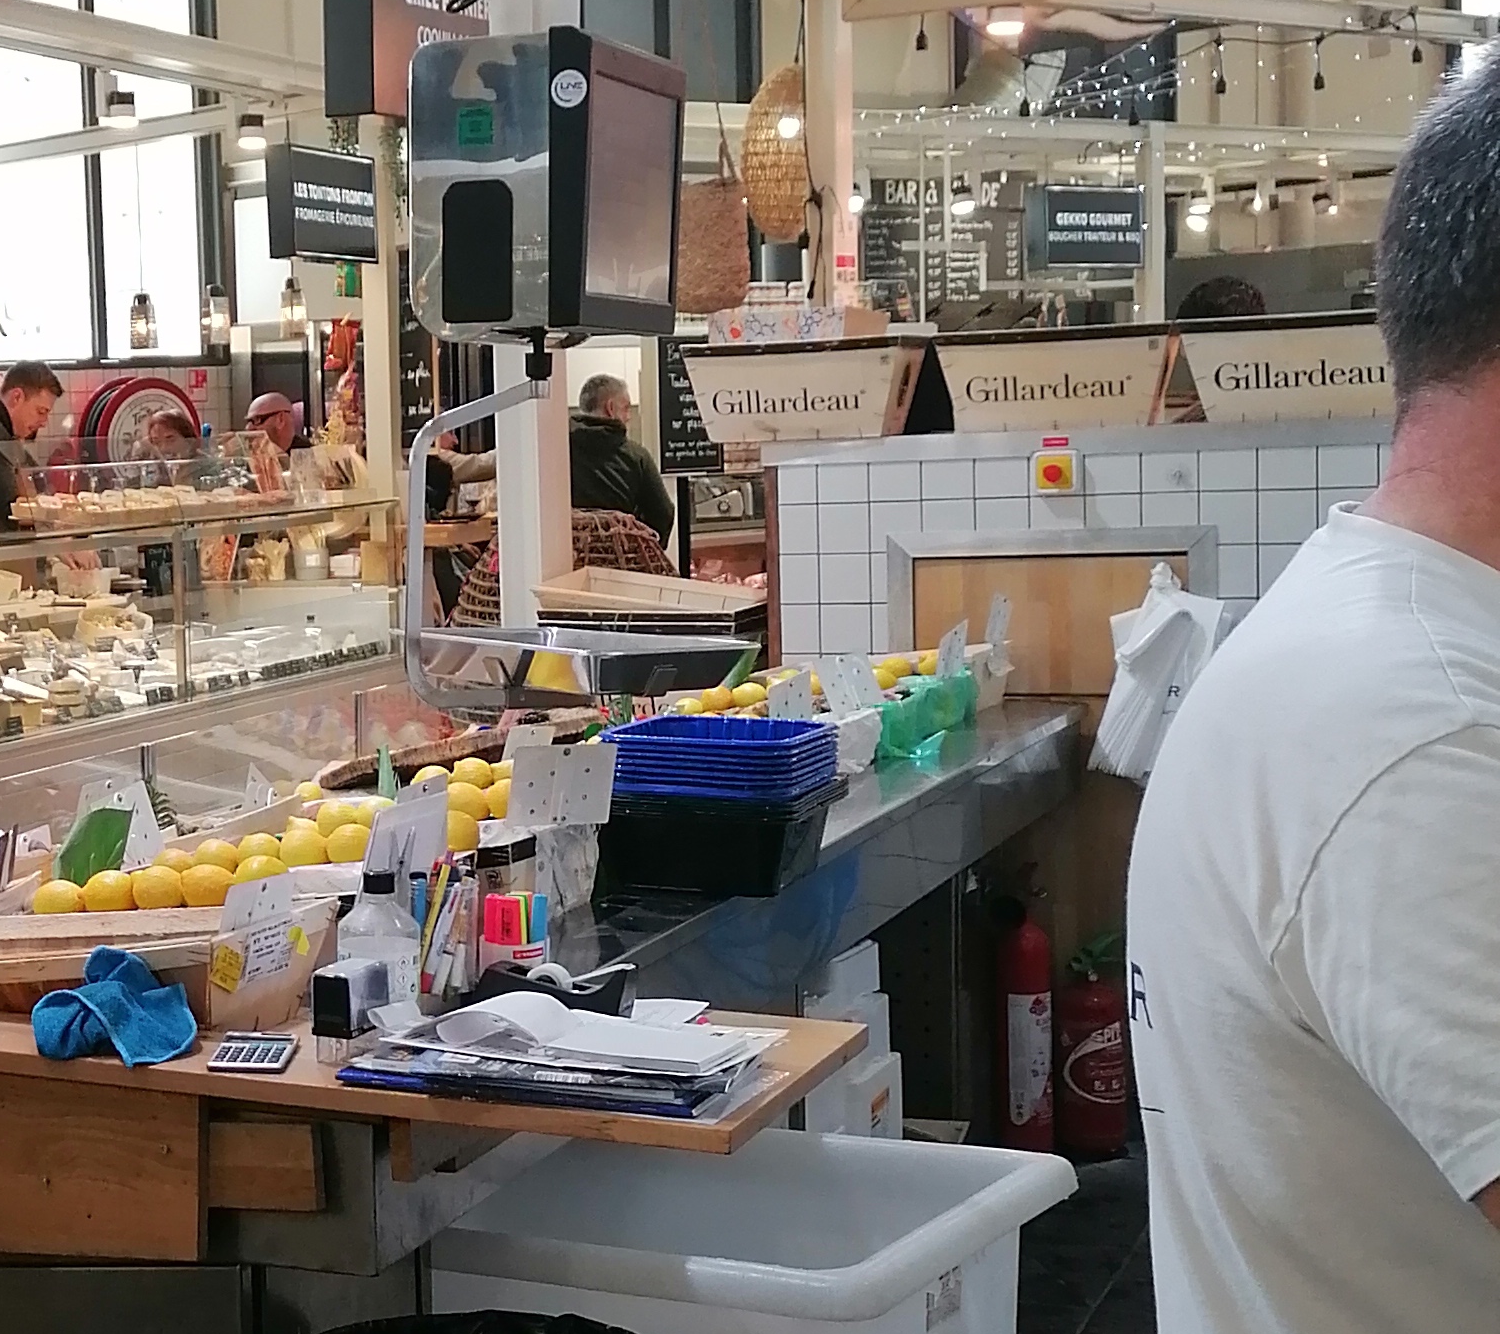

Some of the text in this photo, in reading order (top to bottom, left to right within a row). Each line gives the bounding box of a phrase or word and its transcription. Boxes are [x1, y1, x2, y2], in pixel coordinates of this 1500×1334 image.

[293, 181, 308, 199] LES
[885, 179, 918, 205] BAR
[1055, 211, 1134, 227] GEKKO GOURMET
